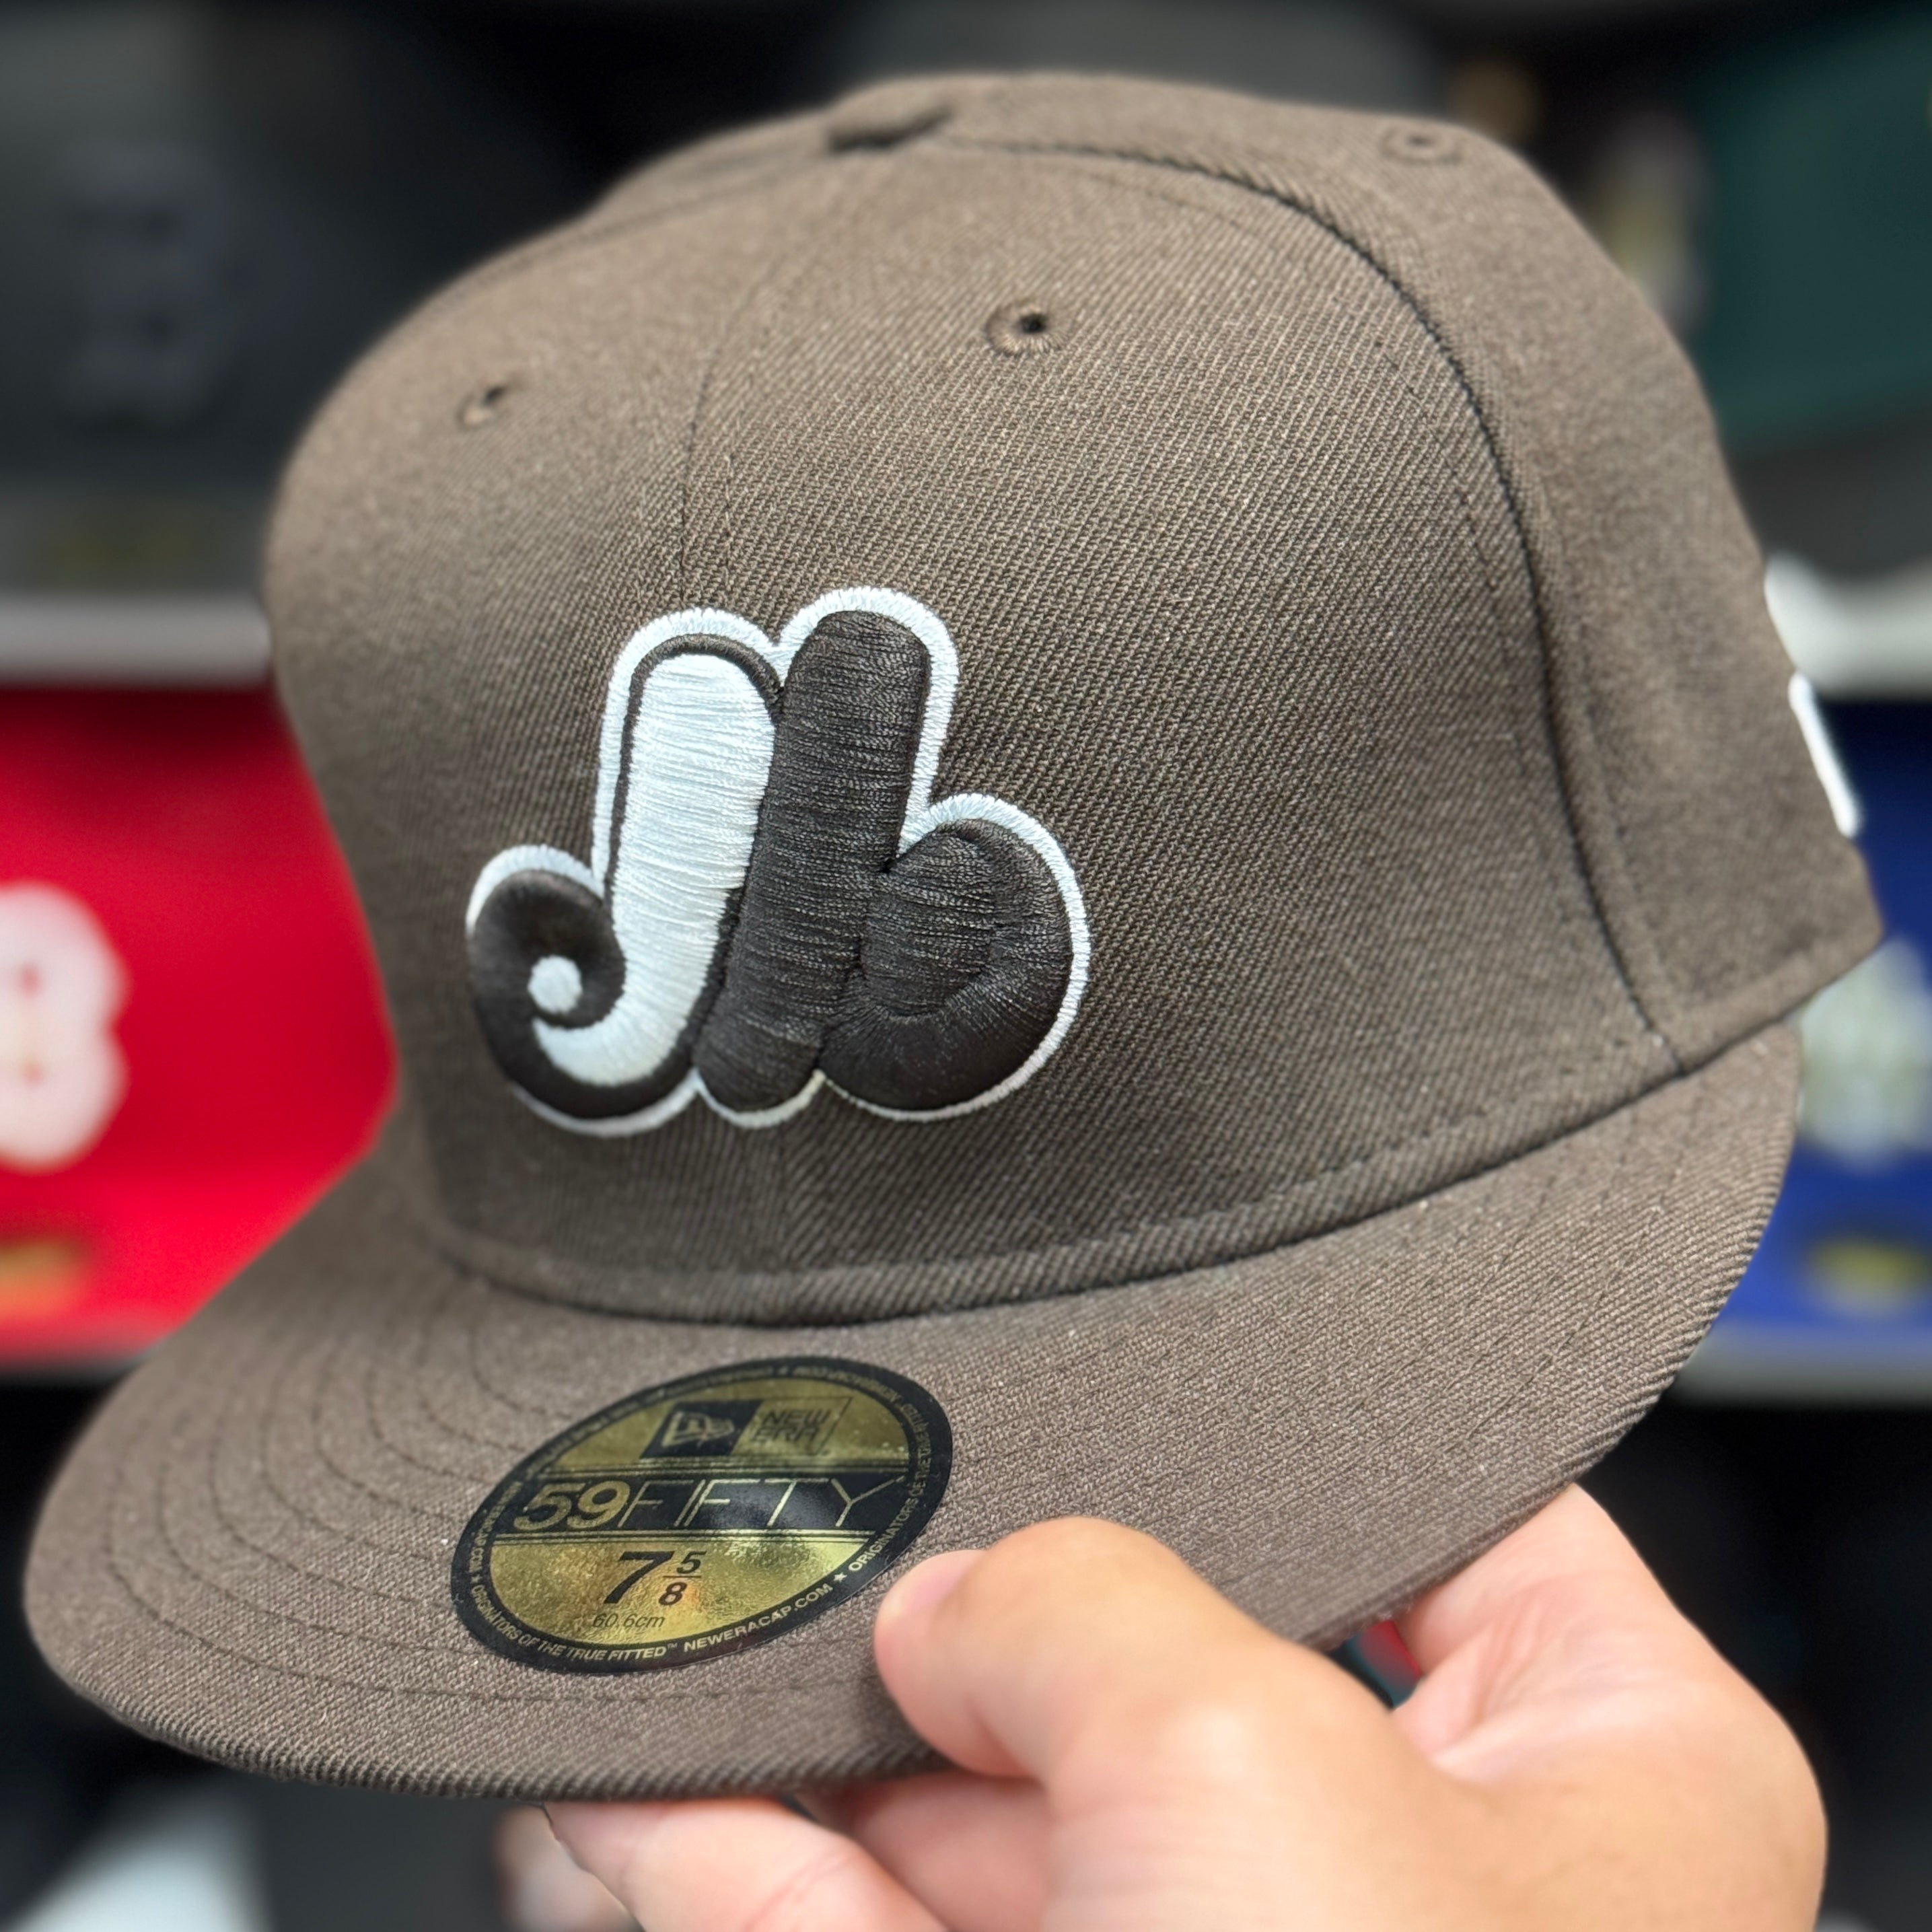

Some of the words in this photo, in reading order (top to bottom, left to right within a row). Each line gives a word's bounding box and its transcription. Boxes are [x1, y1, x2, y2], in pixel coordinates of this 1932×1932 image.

[761, 1409, 832, 1425] NEW
[753, 1425, 820, 1442] ERA
[513, 1476, 905, 1530] 59FIFTY
[849, 1497, 919, 1571] ORIGINATORS
[676, 1551, 707, 1575] 5
[604, 1551, 675, 1604] 7
[658, 1582, 688, 1606] 8
[471, 1585, 522, 1641] ORIGINATORS
[518, 1633, 540, 1647] OF
[538, 1641, 567, 1656] THE
[567, 1646, 607, 1661] TRUE
[684, 1583, 834, 1653] NEWERACAP.COM
[592, 1614, 666, 1628] 60.6cm
